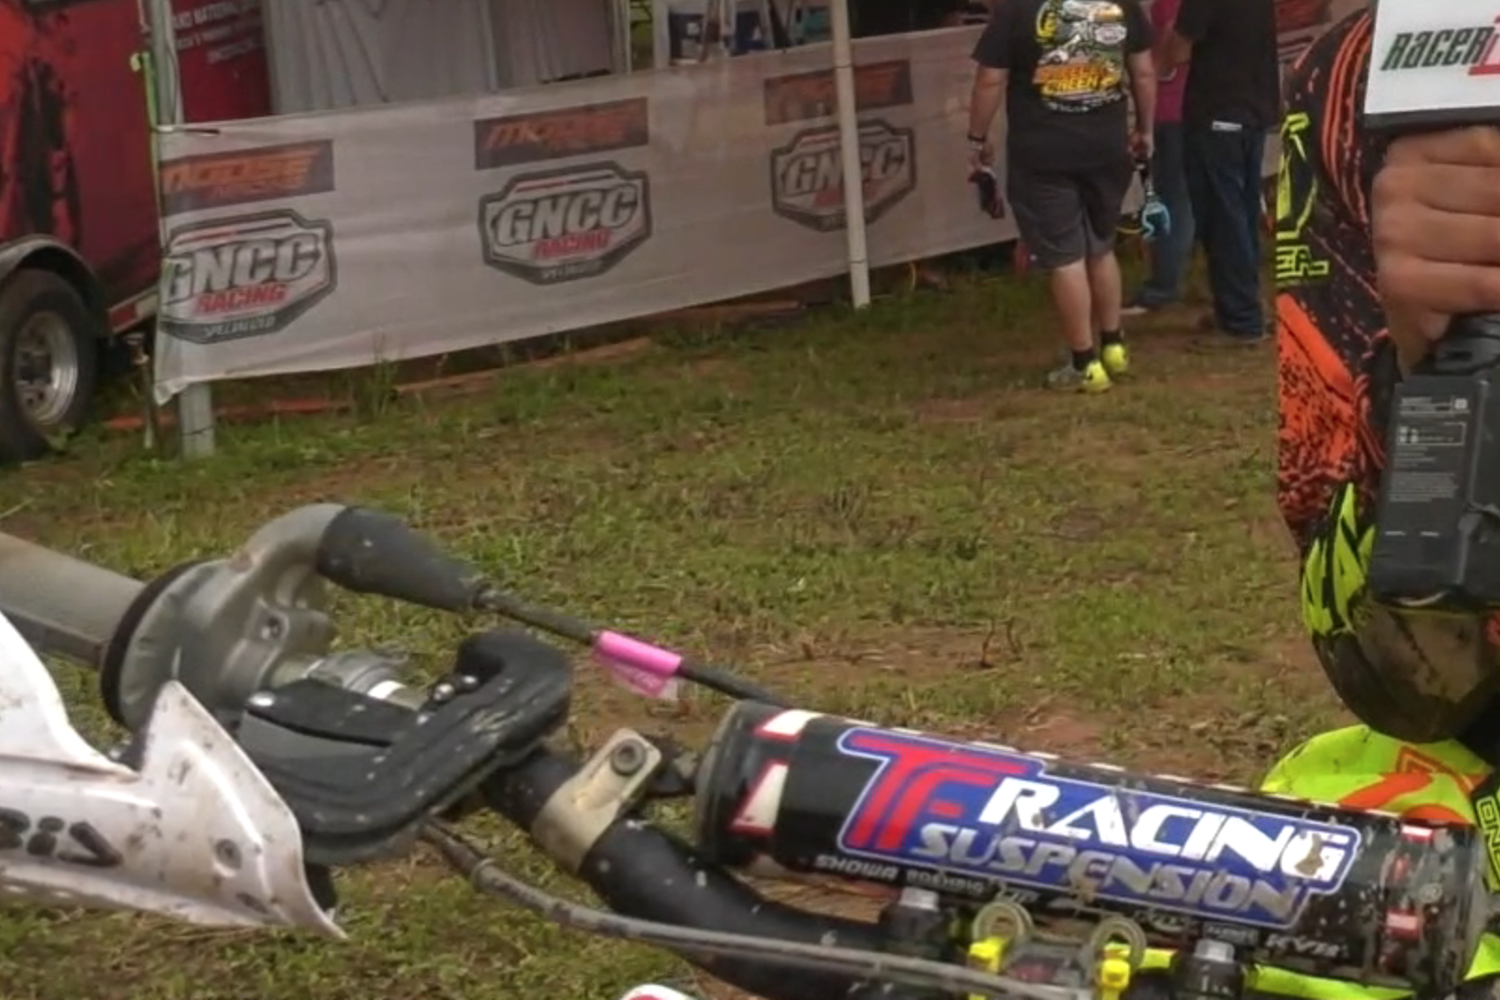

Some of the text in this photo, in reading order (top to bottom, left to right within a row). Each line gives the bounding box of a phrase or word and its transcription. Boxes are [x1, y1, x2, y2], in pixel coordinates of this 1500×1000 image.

[491, 183, 638, 247] GNCC
[193, 284, 289, 315] RACING
[978, 777, 1349, 882] RACING
[814, 854, 899, 881] SHOWA
[911, 822, 1303, 922] SUSPENSION
